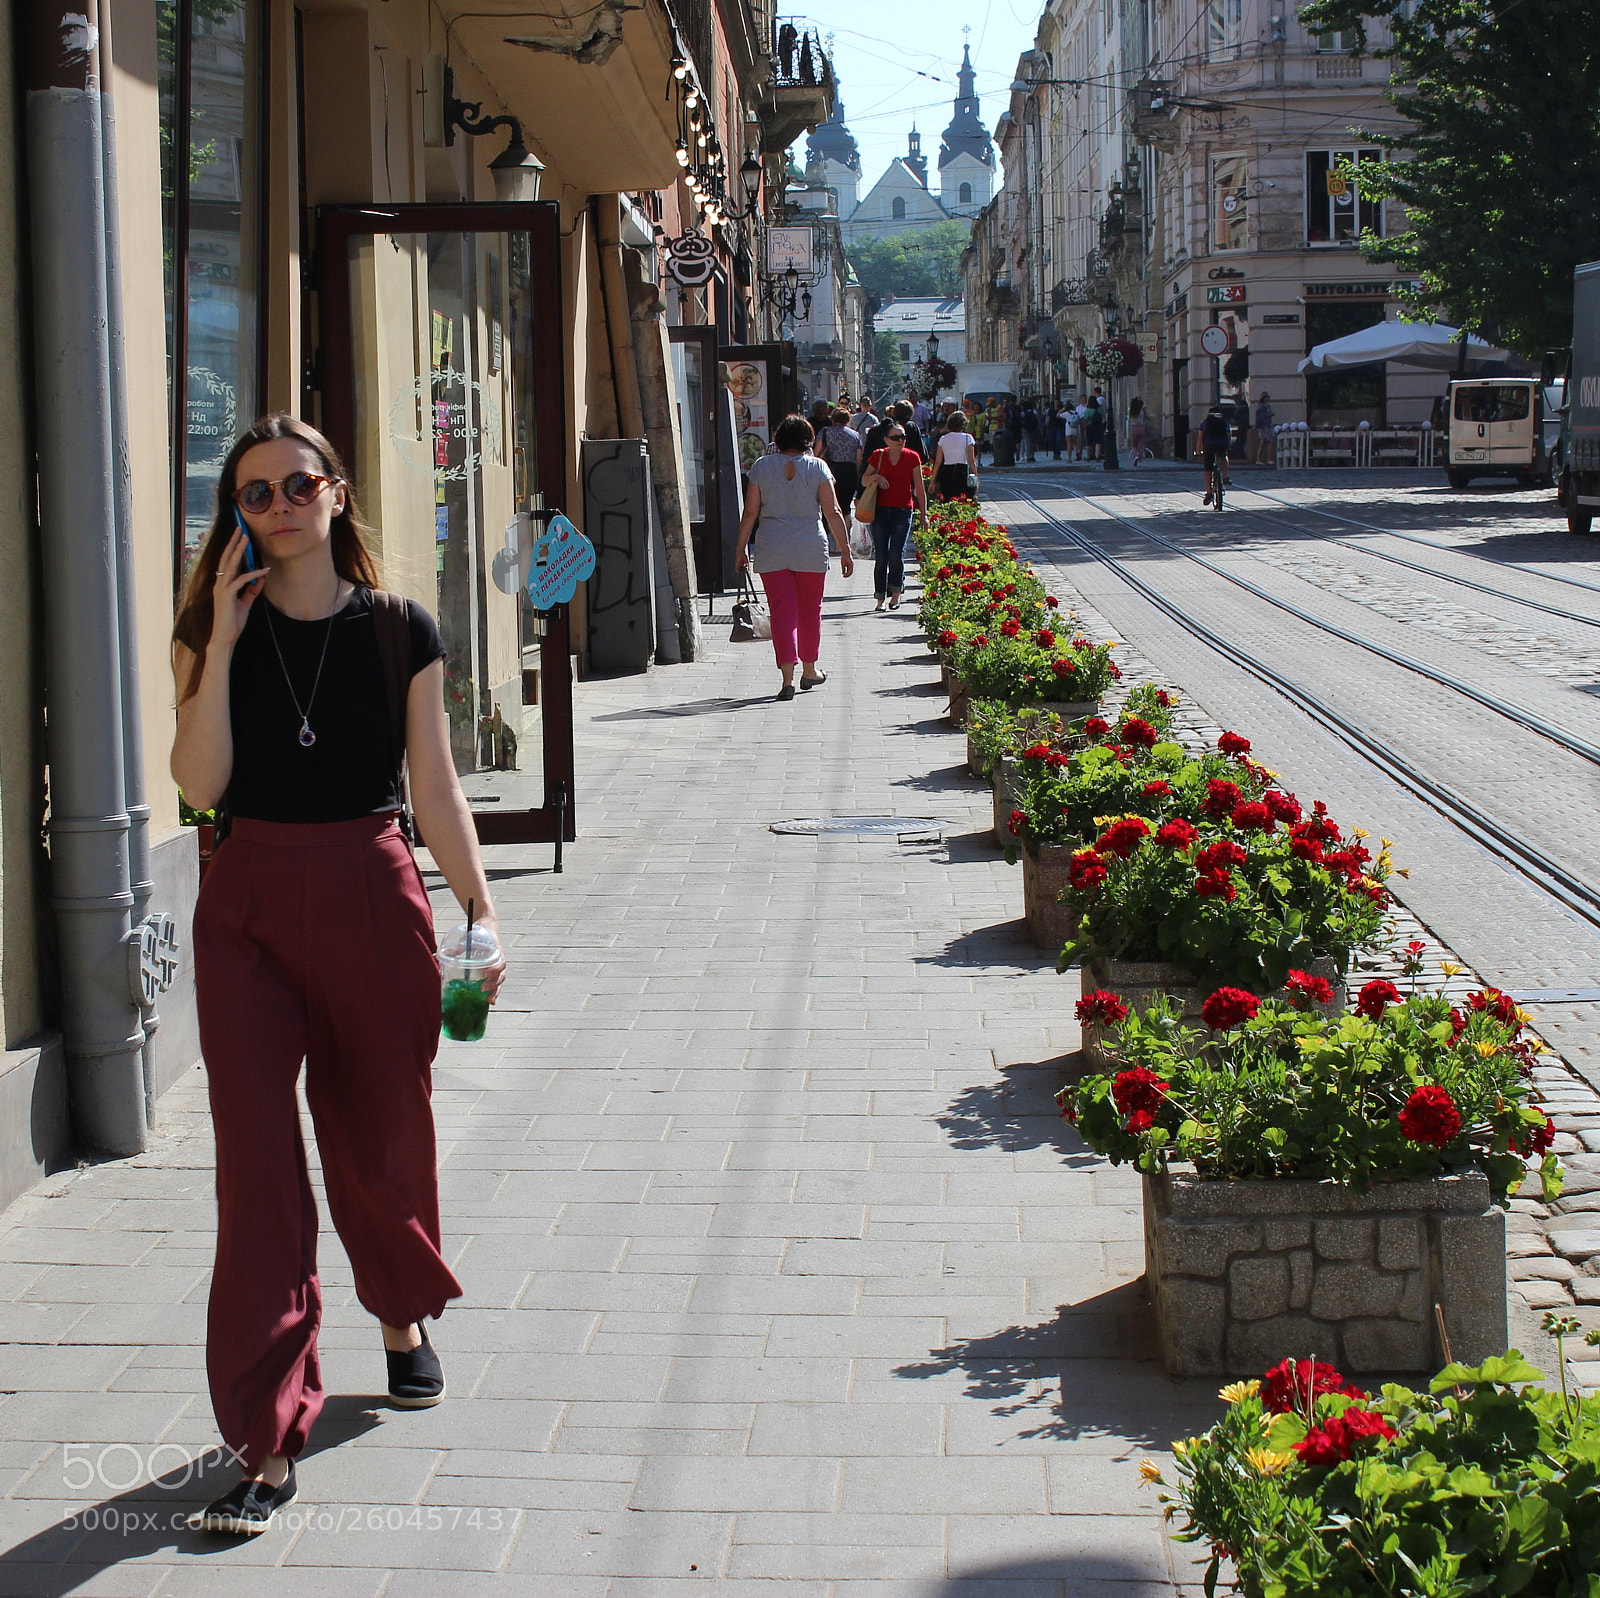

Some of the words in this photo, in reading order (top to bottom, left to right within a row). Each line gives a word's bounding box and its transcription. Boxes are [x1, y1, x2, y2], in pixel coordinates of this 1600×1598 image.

[187, 400, 215, 409] роботи
[191, 411, 207, 423] Нд
[187, 424, 219, 436] 22:00
[538, 544, 575, 582] ШОКОЛАДКИ
[541, 546, 587, 592] ПЕРЕДБАЧЕННЯМ
[542, 585, 561, 604] fortune
[561, 559, 587, 586] chocolates
